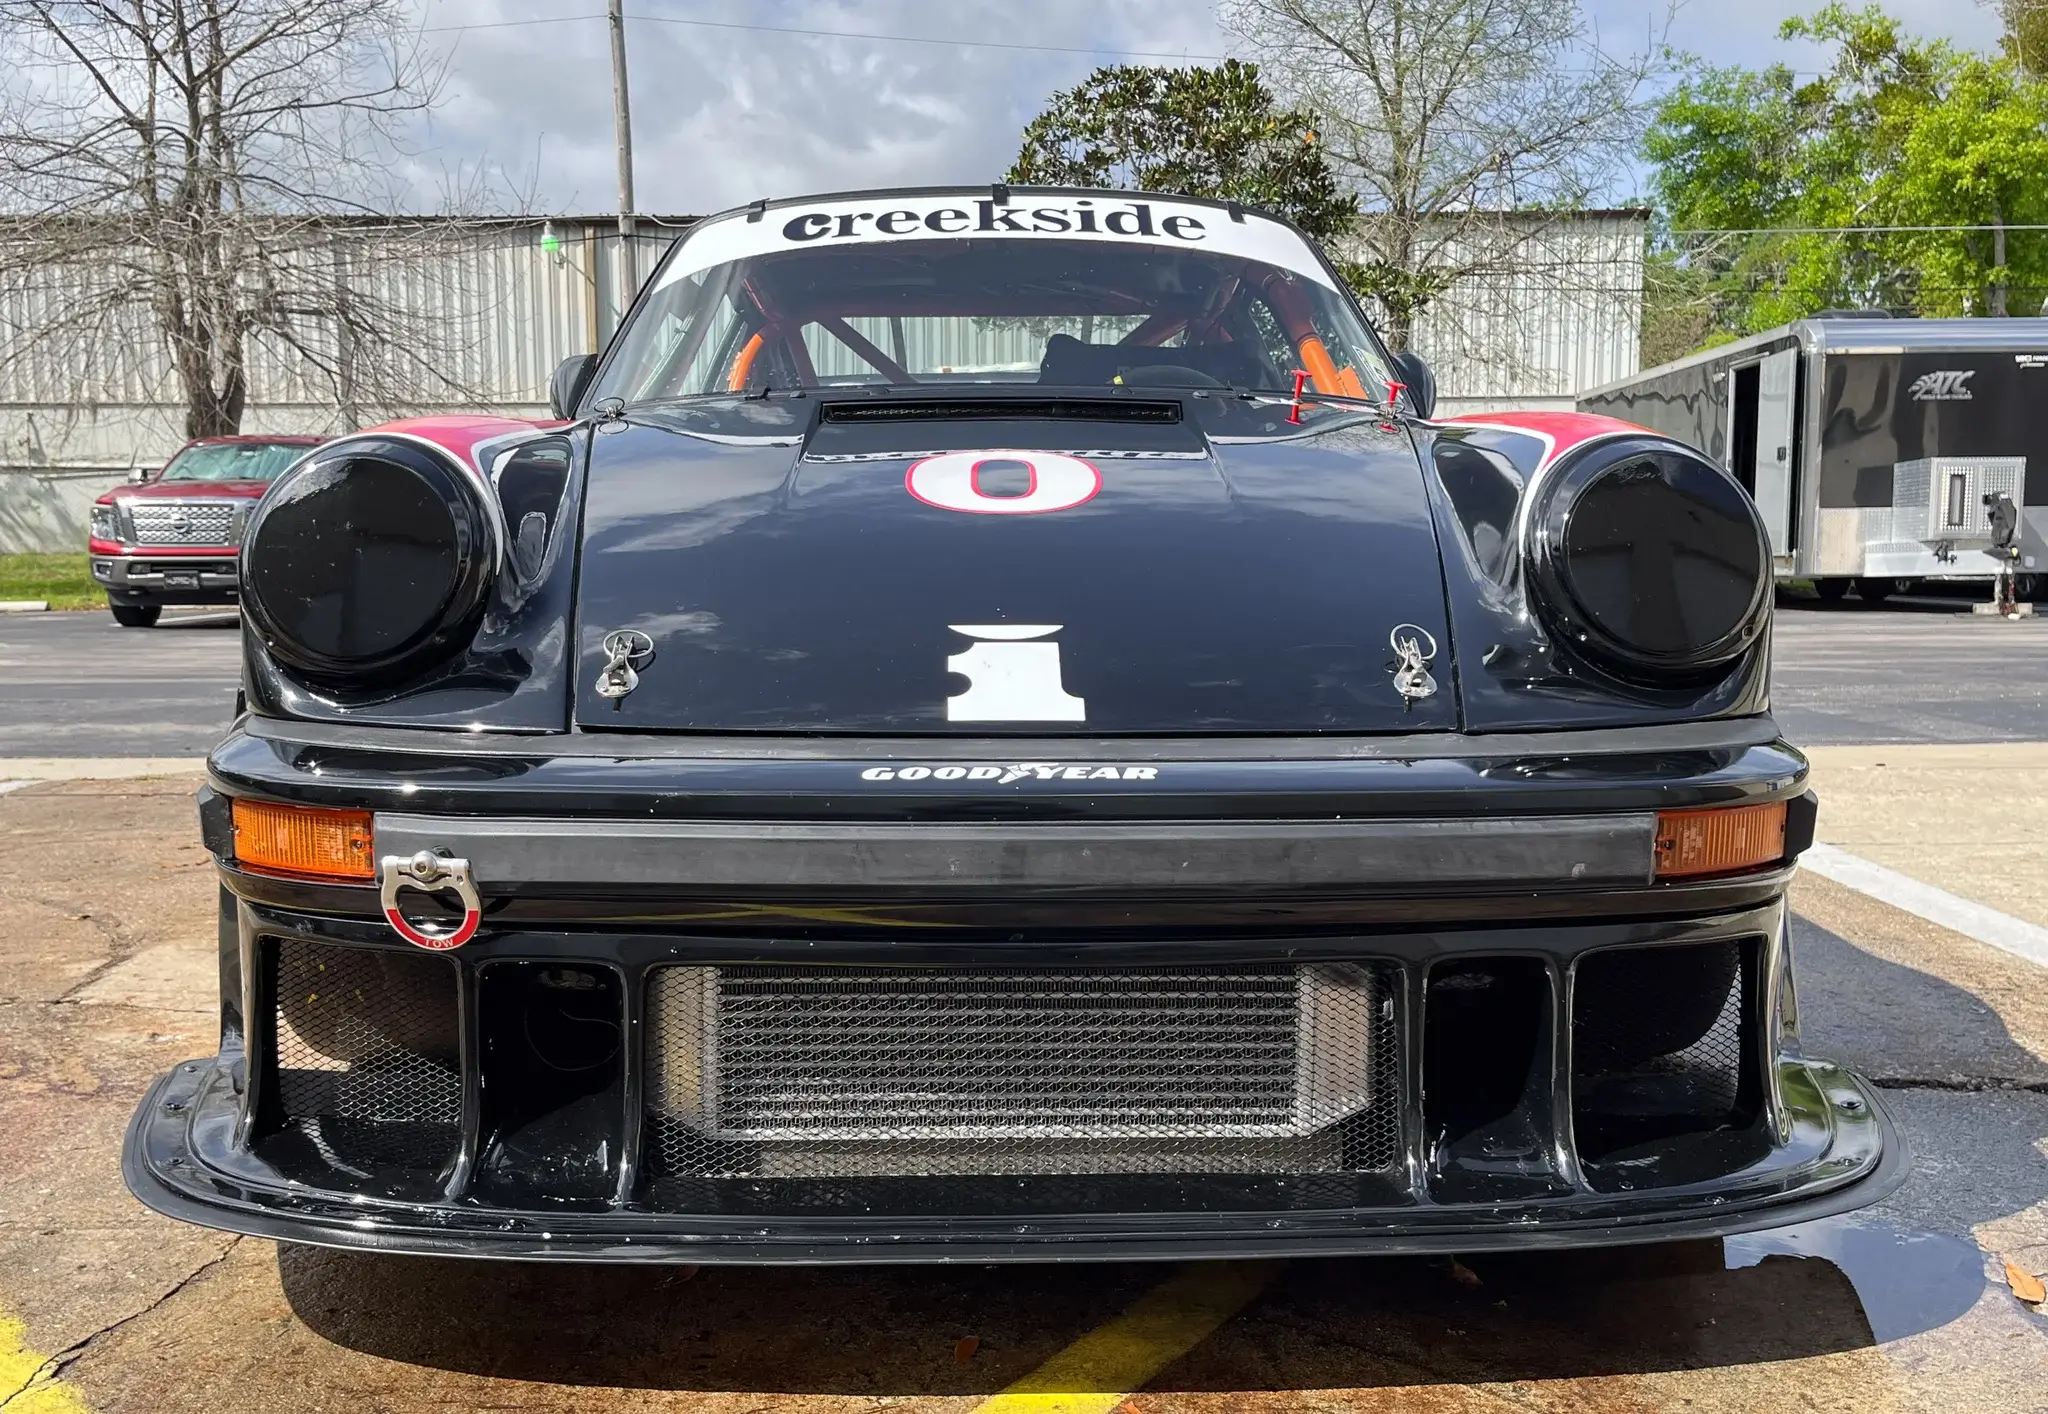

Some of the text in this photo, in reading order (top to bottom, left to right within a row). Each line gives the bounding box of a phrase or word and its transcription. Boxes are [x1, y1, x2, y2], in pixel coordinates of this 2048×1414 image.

[782, 199, 1207, 242] creekside
[1911, 370, 1976, 395] ATC
[861, 762, 1158, 783] GOODYEAR
[425, 939, 454, 948] TOW
